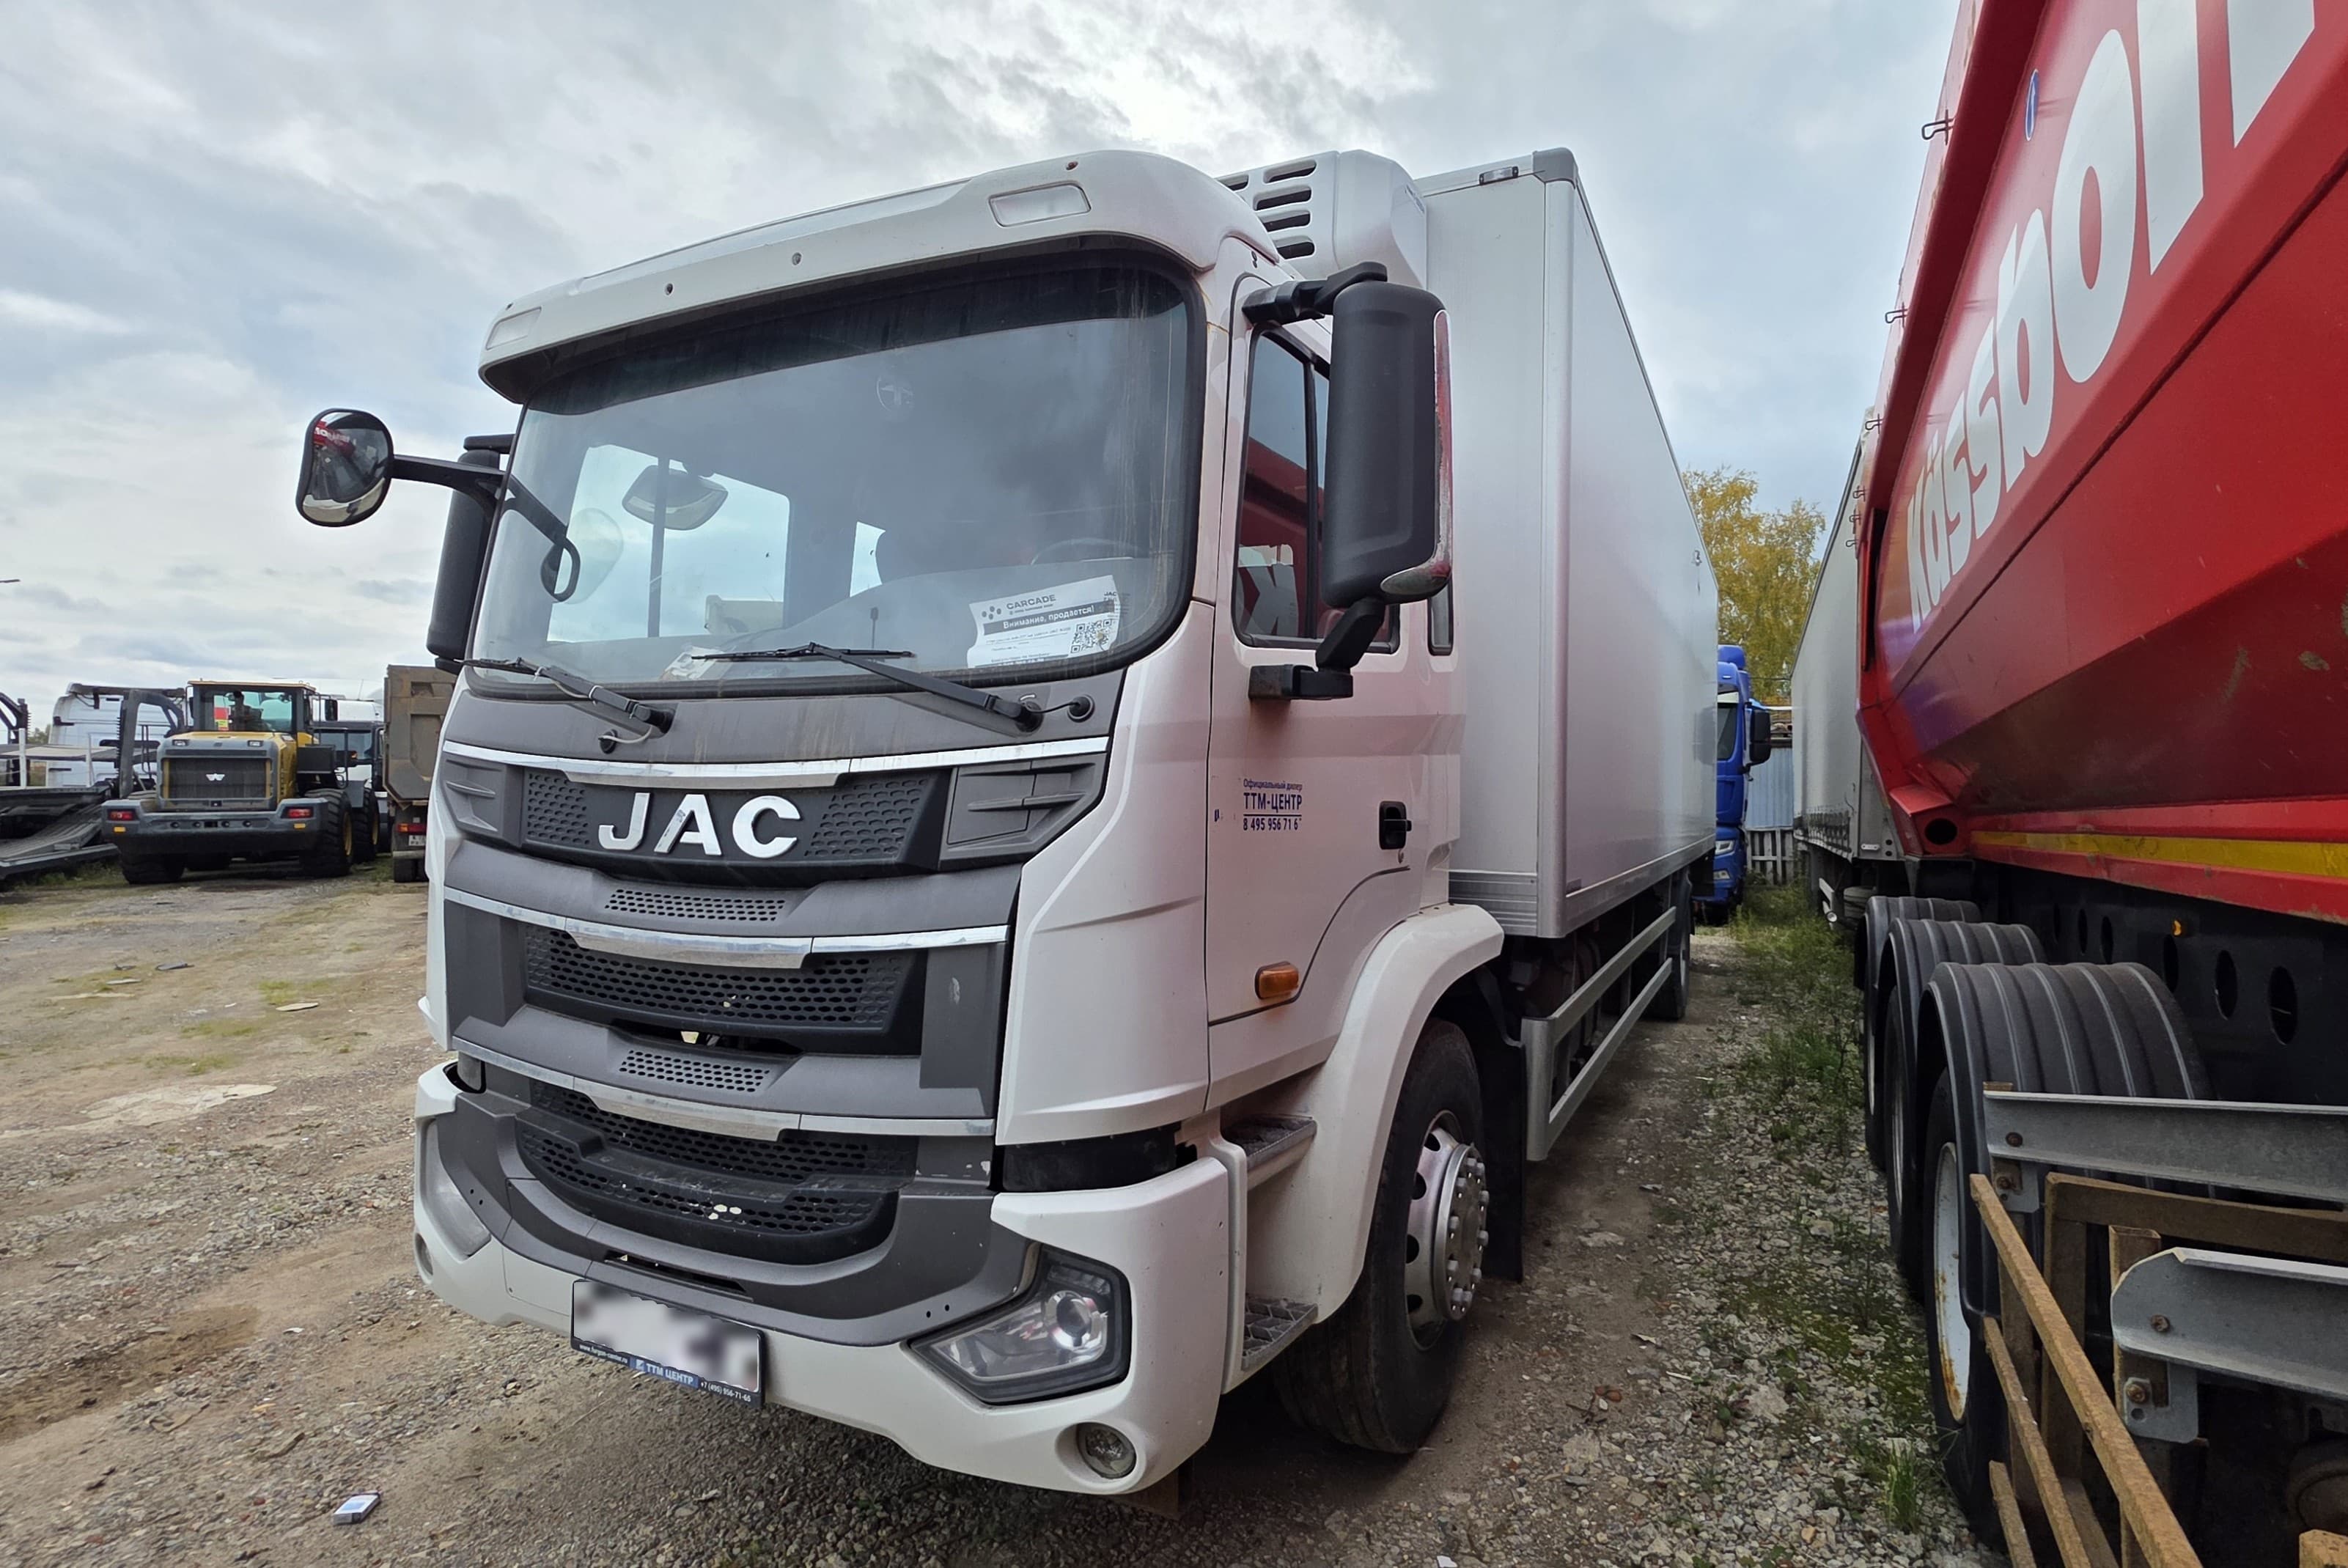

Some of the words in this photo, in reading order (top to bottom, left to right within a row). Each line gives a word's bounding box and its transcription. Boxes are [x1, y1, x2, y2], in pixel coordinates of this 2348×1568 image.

[1006, 595, 1056, 610] CARCADE
[1003, 616, 1047, 629] Внимание,
[1243, 792, 1302, 813] ТТМ-ЦЕНТР
[598, 792, 801, 858] JAC
[1243, 817, 1248, 831] 8
[1251, 817, 1265, 831] 495
[1268, 817, 1281, 831] 956
[1283, 817, 1291, 830] 71
[646, 1363, 663, 1376] ТТМ
[665, 1369, 693, 1384] ЦЕНТР
